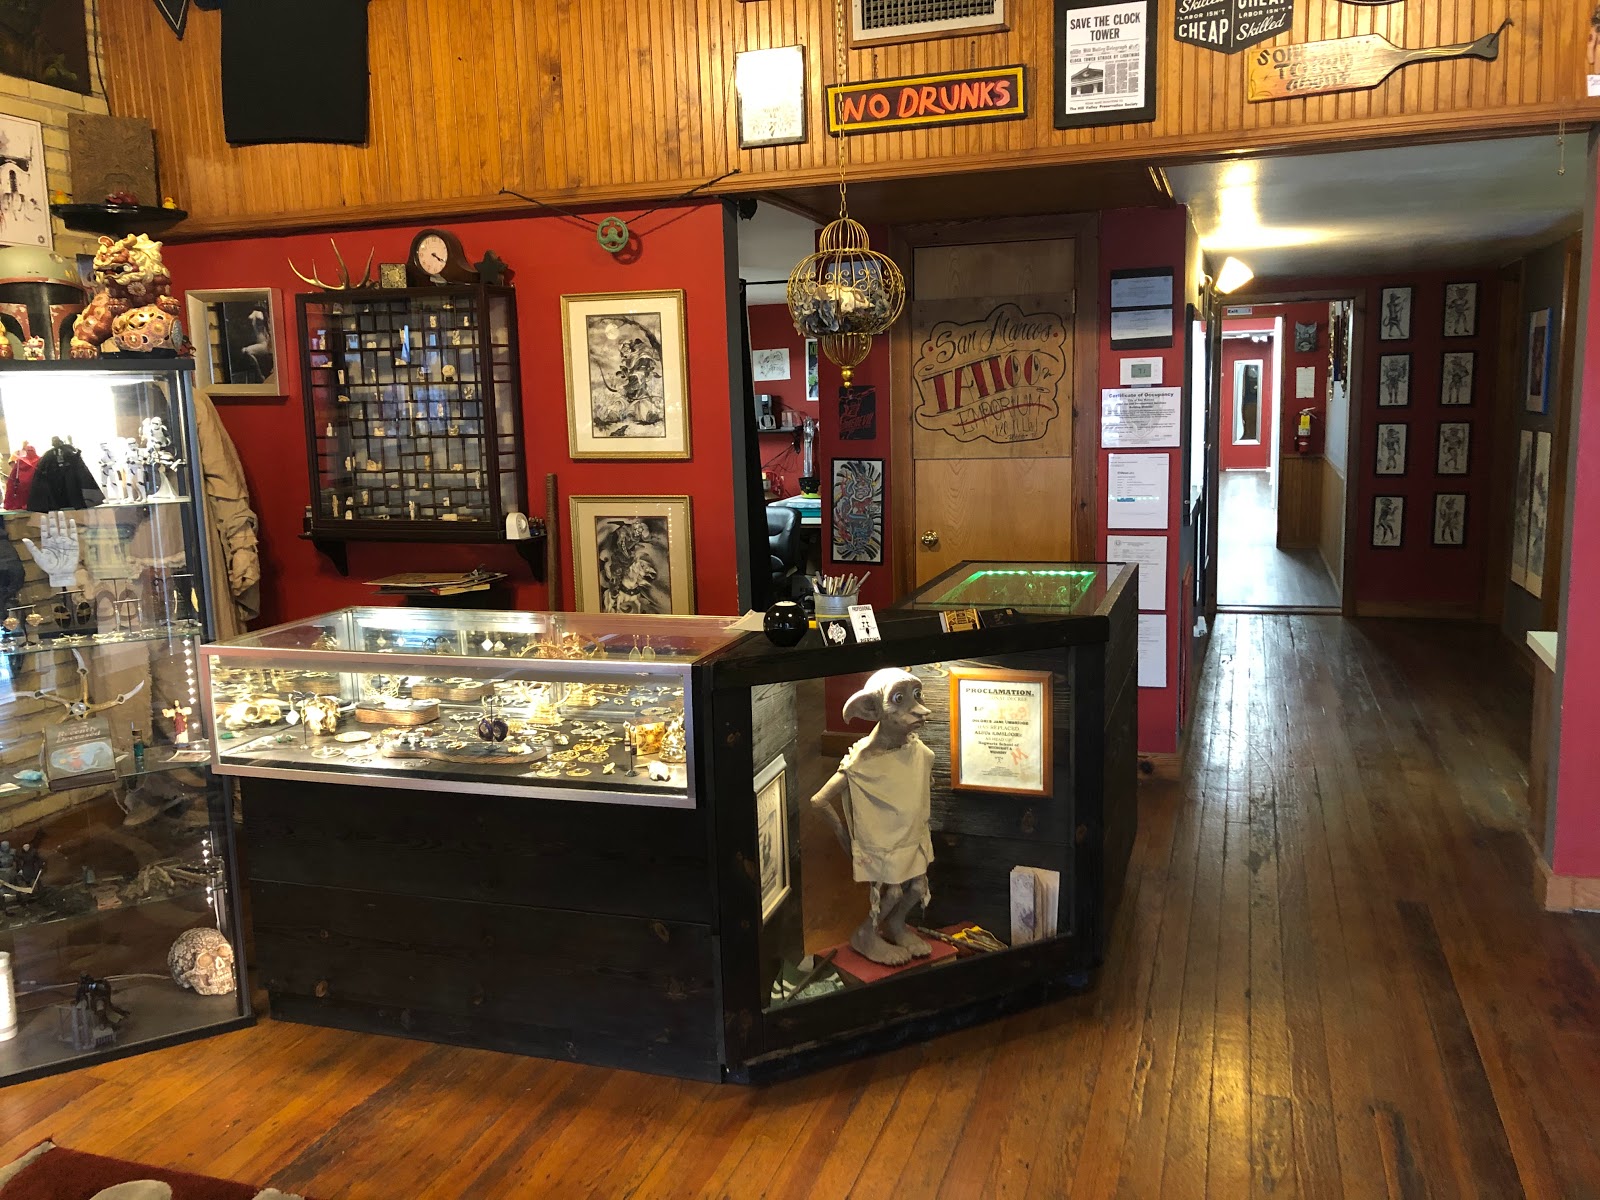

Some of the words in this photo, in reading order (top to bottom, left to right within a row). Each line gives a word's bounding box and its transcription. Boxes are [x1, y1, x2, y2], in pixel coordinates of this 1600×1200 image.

[1070, 17, 1092, 30] SAVE
[1094, 15, 1110, 27] THE
[1113, 12, 1141, 26] CLOCK
[1206, 9, 1225, 17] ISN'T
[1239, 10, 1263, 18] LABOR
[1090, 28, 1120, 41] TOWER
[1179, 18, 1228, 45] CHEAP
[1236, 13, 1286, 40] Skilled
[843, 93, 890, 121] NO
[898, 80, 1010, 118] DRUNKS
[936, 329, 977, 363] San
[981, 311, 1052, 351] Marcos
[922, 354, 1041, 414] TATTOO
[956, 393, 1041, 435] EMPORIUM
[966, 688, 1035, 697] PROCLAMATION.
[56, 730, 101, 743] Deceased
[57, 727, 96, 737] Recently
